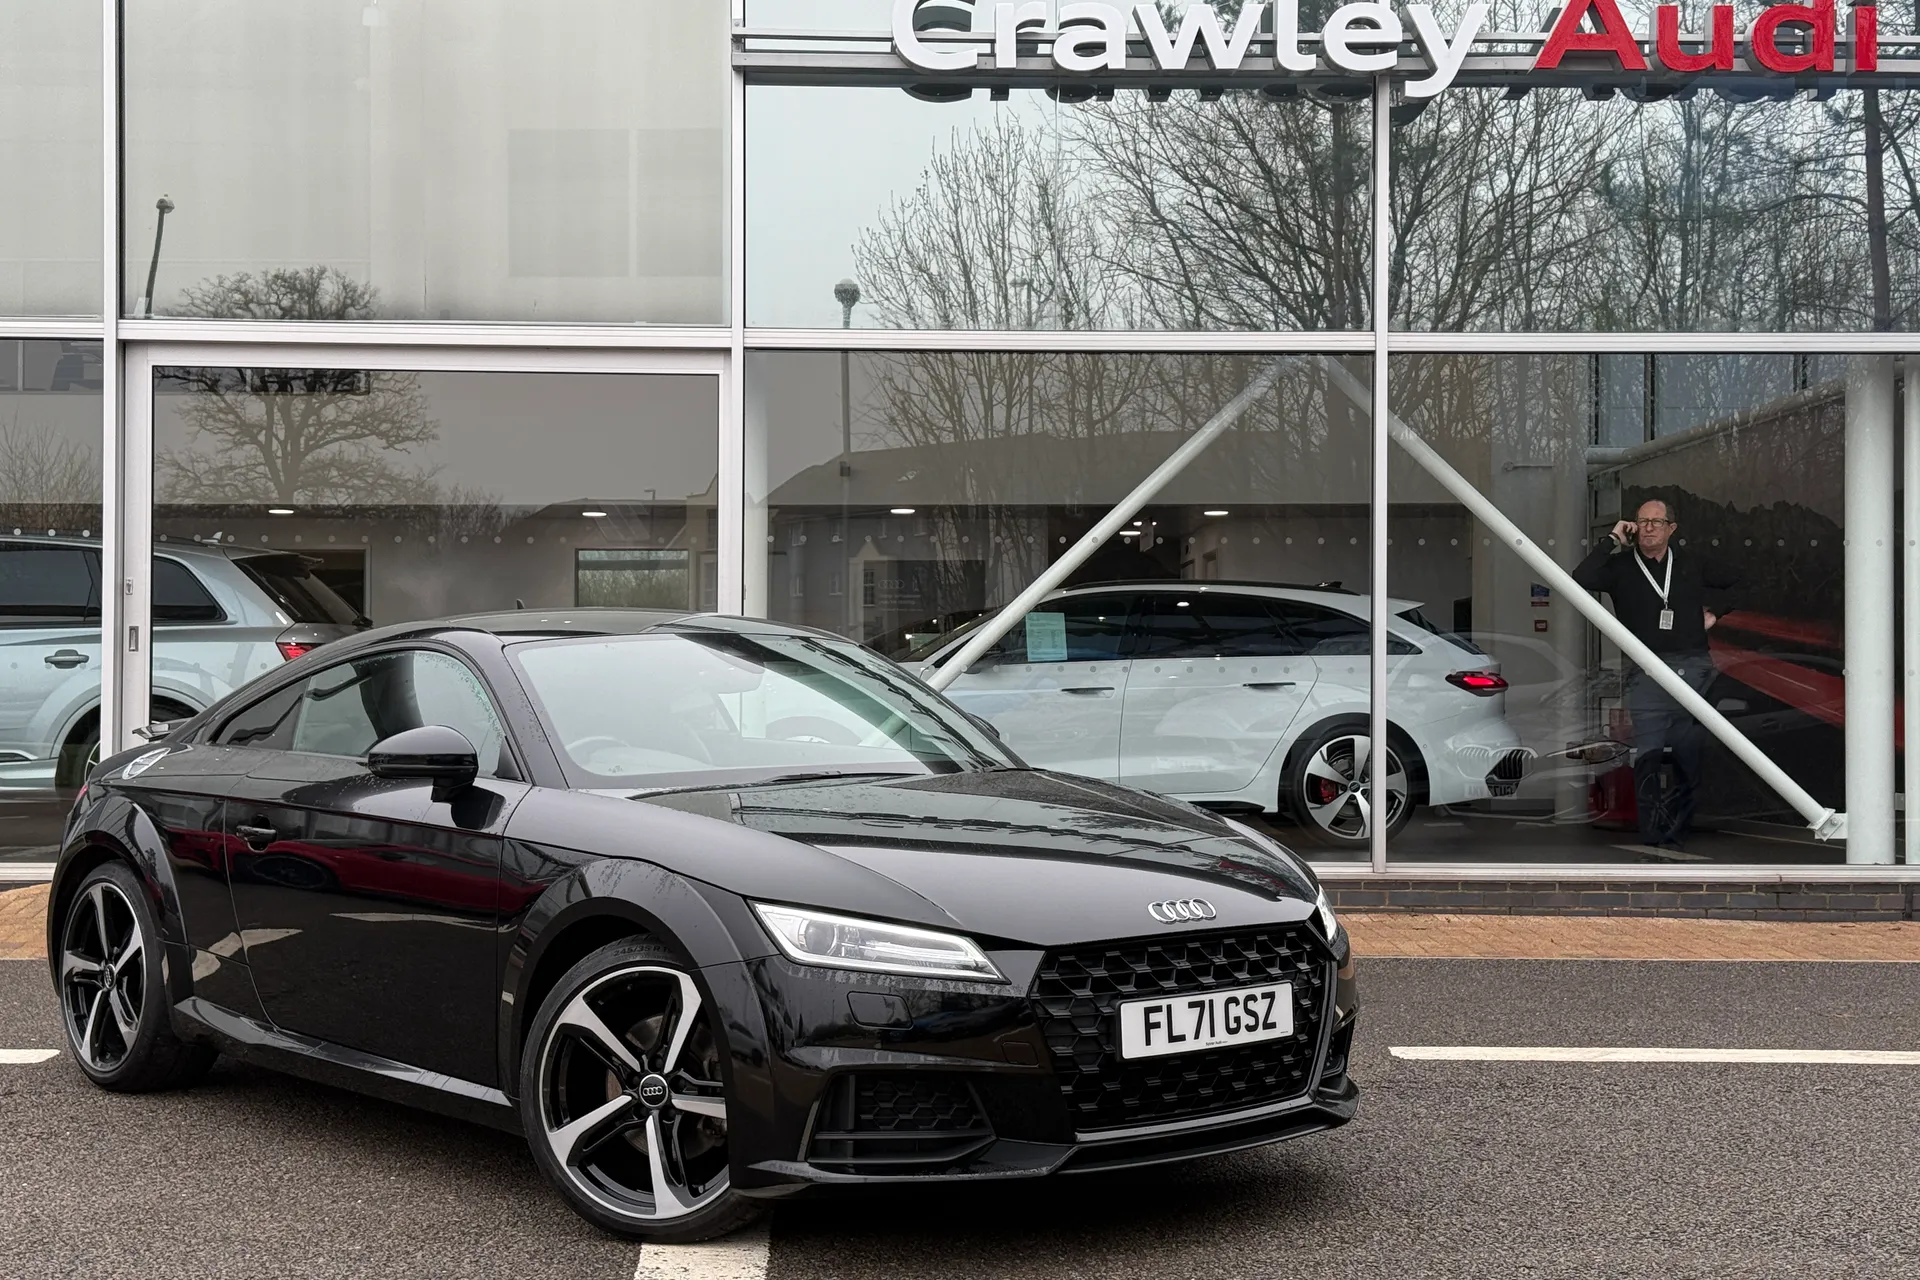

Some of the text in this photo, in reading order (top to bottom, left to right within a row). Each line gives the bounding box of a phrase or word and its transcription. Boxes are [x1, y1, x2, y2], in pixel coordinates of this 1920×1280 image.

[892, 0, 1877, 97] Crawley Audi
[1143, 991, 1277, 1046] FL71 GSZ
